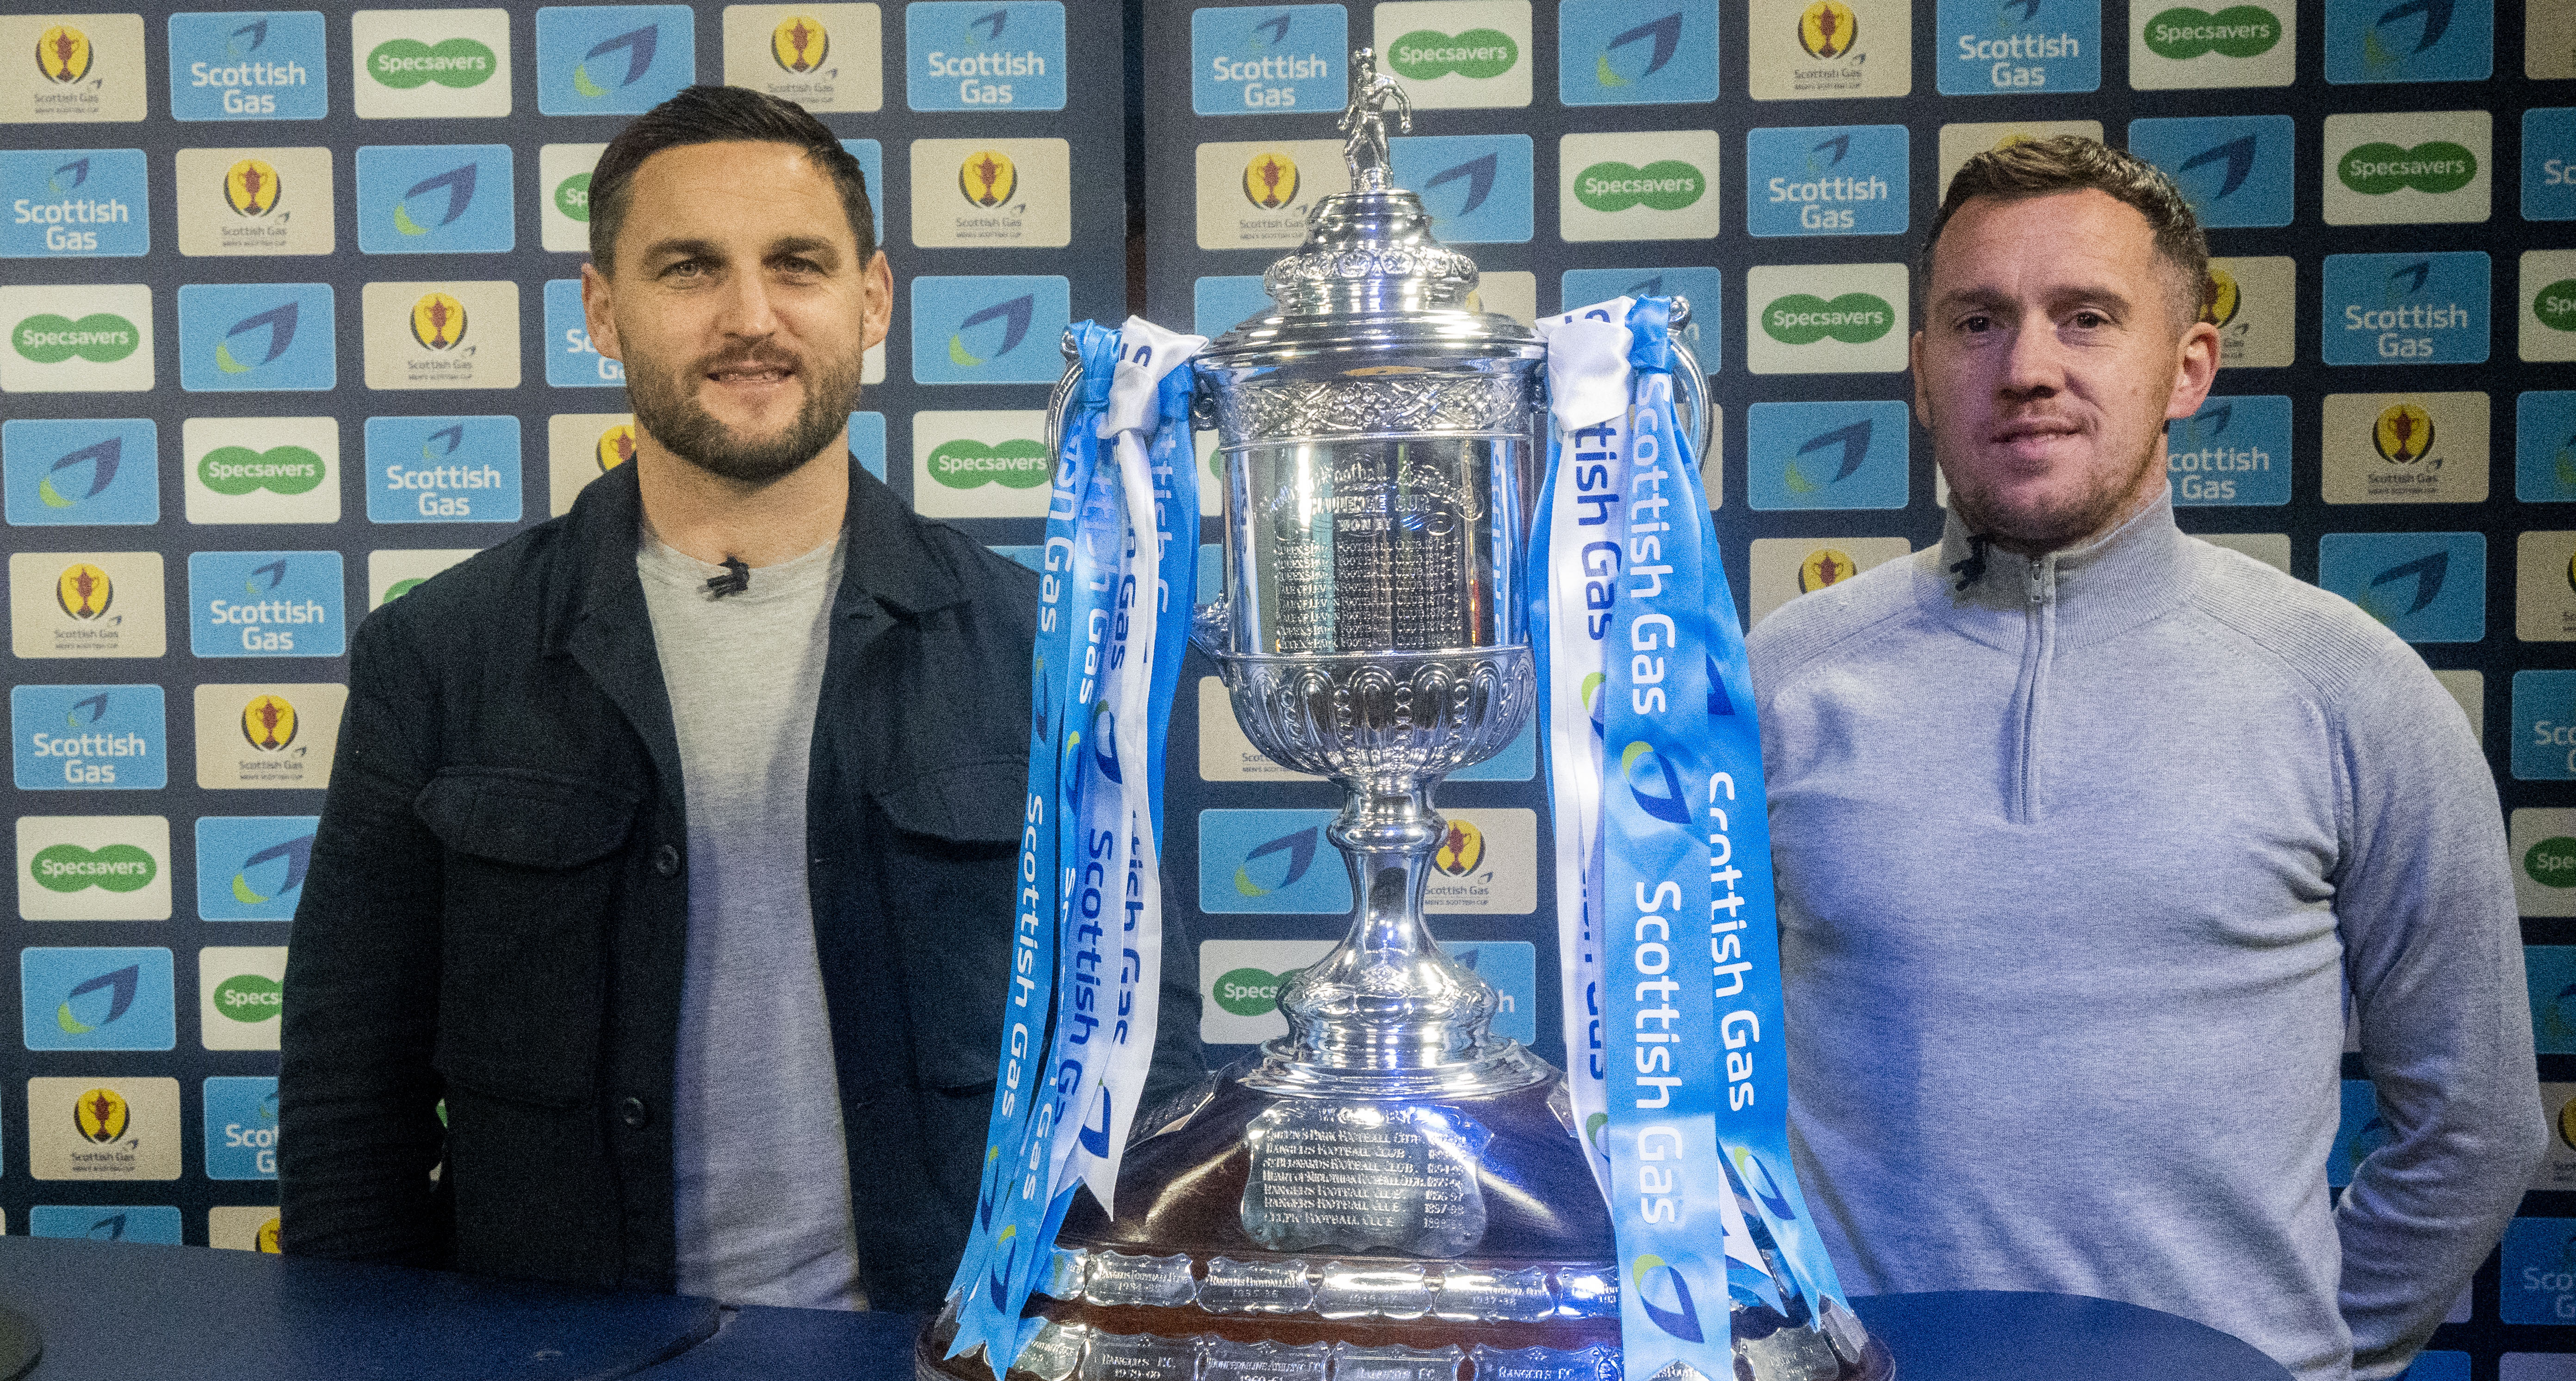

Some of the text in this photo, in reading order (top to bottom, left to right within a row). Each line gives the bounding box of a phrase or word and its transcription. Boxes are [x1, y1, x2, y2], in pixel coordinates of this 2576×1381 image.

[2155, 24, 2270, 44] Specsavers
[1399, 46, 1507, 65] Specsavers
[1960, 34, 2079, 61] Scottish
[191, 62, 306, 86] Scottish
[378, 54, 486, 73] Specsavers
[929, 51, 1045, 78] Scottish
[1213, 54, 1326, 81] Scottish
[1795, 69, 1861, 79] Scottish Gas
[1991, 63, 2044, 87] Gas
[34, 93, 99, 103] Scottish Gas
[223, 89, 275, 114] Gas
[960, 79, 1013, 104] Gas
[1245, 83, 1295, 107] Gas
[2350, 159, 2465, 179] Specsavers
[1585, 177, 1694, 197] Specsavers
[1770, 177, 1887, 202] Scottish
[14, 199, 128, 224] Scottish
[956, 218, 1022, 227] Scottish Gas
[1240, 219, 1304, 228] Scottish Gas
[1801, 204, 1855, 229] Gas
[46, 226, 97, 251] Gas
[222, 227, 286, 236] Scottish Gas
[1773, 310, 1883, 329] Specsavers
[2345, 304, 2467, 331] Scottish
[23, 329, 129, 348] Specsavers
[2378, 333, 2433, 358] Gas
[408, 360, 472, 370] Scottish Gas
[209, 461, 315, 480] Specsavers
[939, 455, 1047, 474] Specsavers
[2168, 446, 2269, 472] cottish
[387, 465, 501, 491] Scottish
[2181, 475, 2235, 500] Gas
[419, 493, 471, 517] Gas
[1630, 374, 1676, 715] Scottish Gas
[1041, 536, 1075, 633] Gas
[1583, 541, 1622, 641] Gas
[210, 600, 324, 627] Scottish
[54, 630, 118, 639] Scottish Gas
[242, 627, 293, 651] Gas
[1079, 608, 1109, 704] Gas
[33, 733, 146, 759] Scottish
[65, 760, 115, 784] Gas
[240, 761, 303, 770] Scottish Gas
[42, 859, 147, 877] Specsavers
[1425, 886, 1489, 895] Scottish Gas
[1070, 828, 1113, 1045] Scottish
[1002, 793, 1043, 1118] Scottish Gas
[224, 989, 282, 1007] Specs
[1225, 982, 1278, 1001] Specs
[1635, 881, 1683, 1225] Scottish Gas
[1720, 1010, 1760, 1111] Gas
[71, 1153, 135, 1162] Scottish Gas
[1022, 1103, 1052, 1201] Gas
